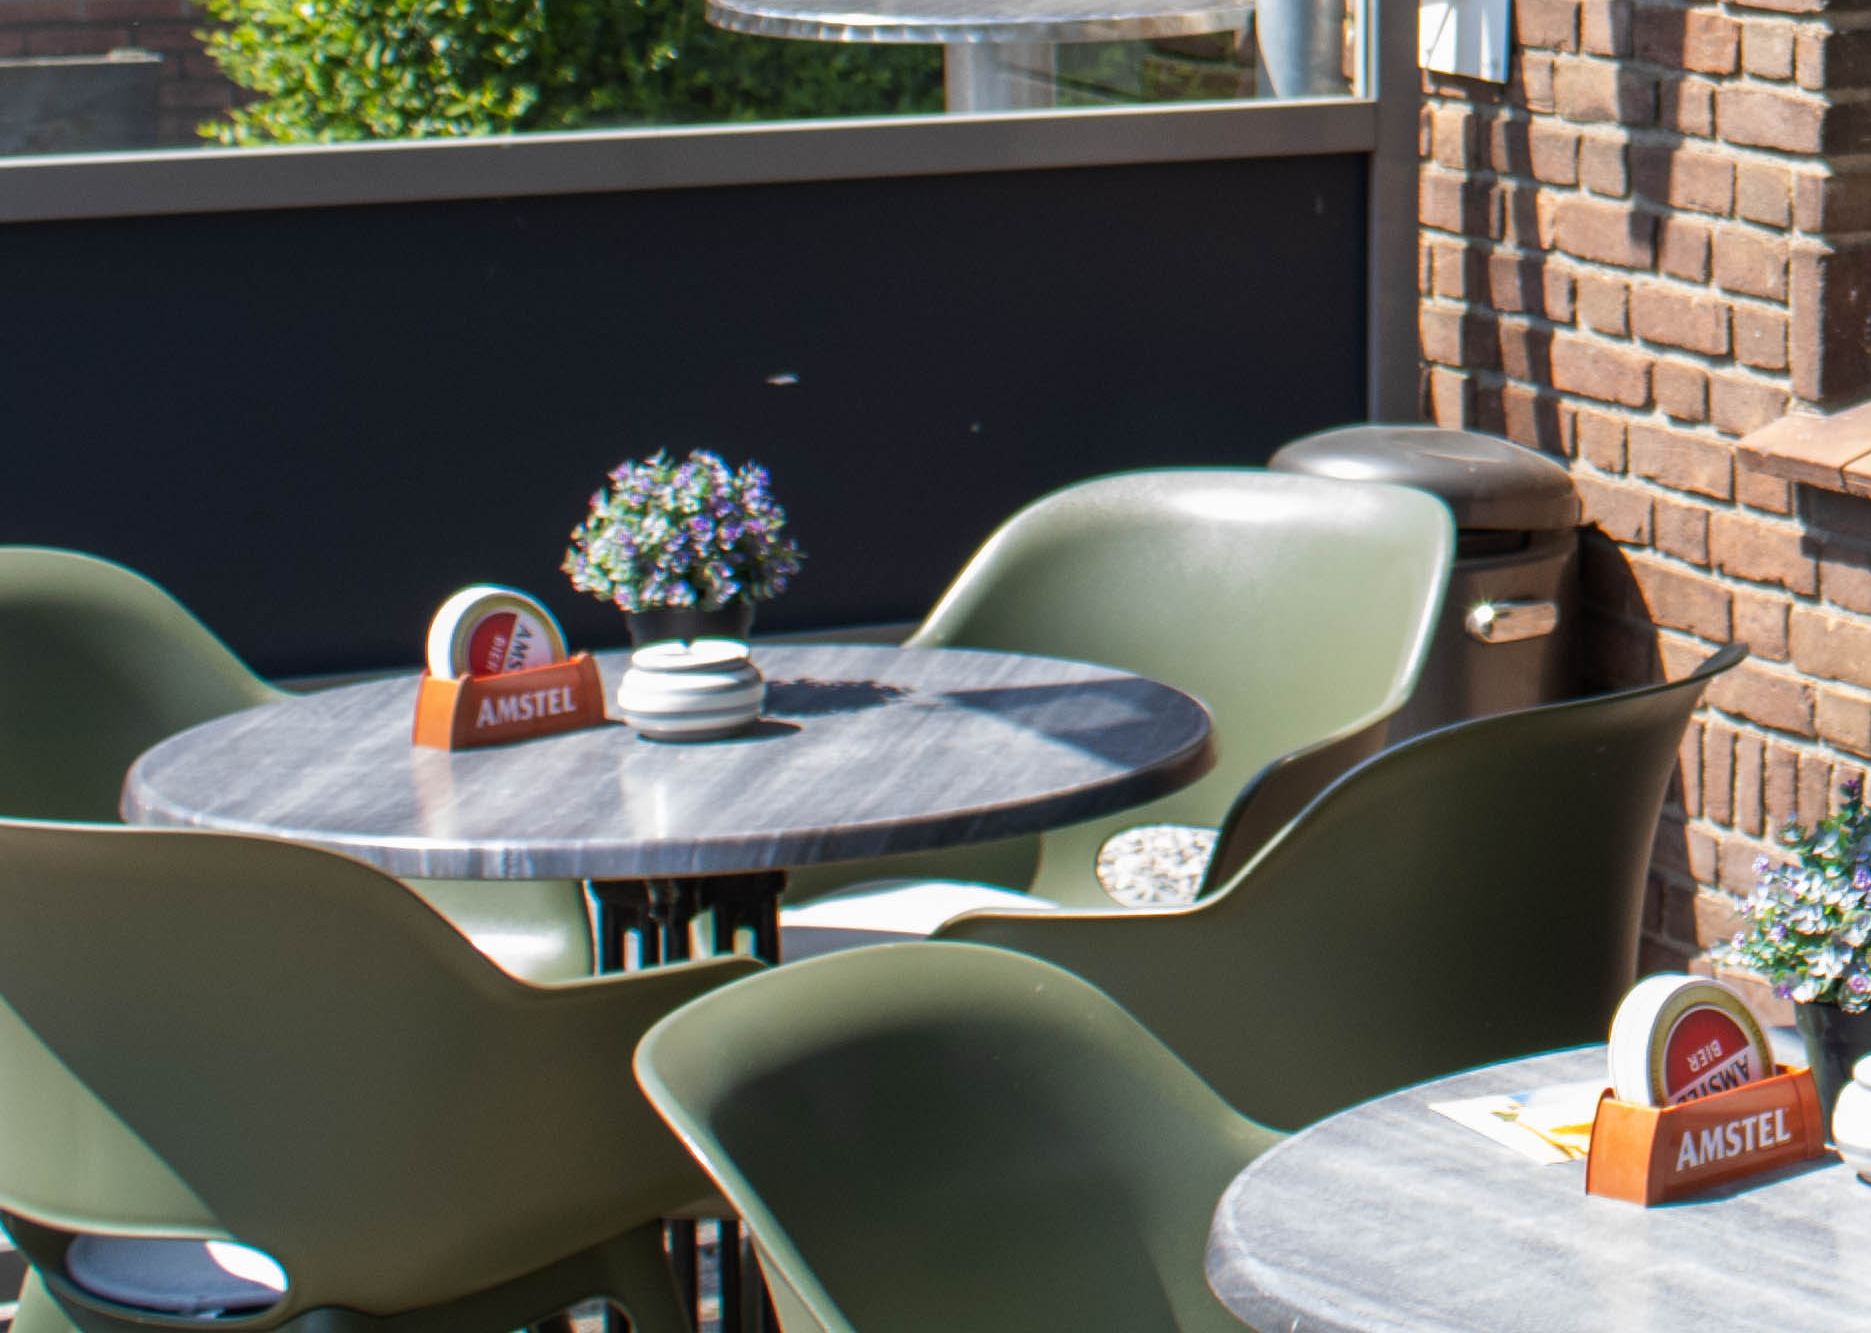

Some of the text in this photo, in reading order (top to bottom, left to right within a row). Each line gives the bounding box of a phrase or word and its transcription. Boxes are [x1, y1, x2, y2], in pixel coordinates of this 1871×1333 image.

[509, 624, 531, 669] AMS
[477, 686, 577, 727] AMSTEL
[1687, 1038, 1722, 1072] BIER
[1675, 1108, 1792, 1172] AMSTEL
